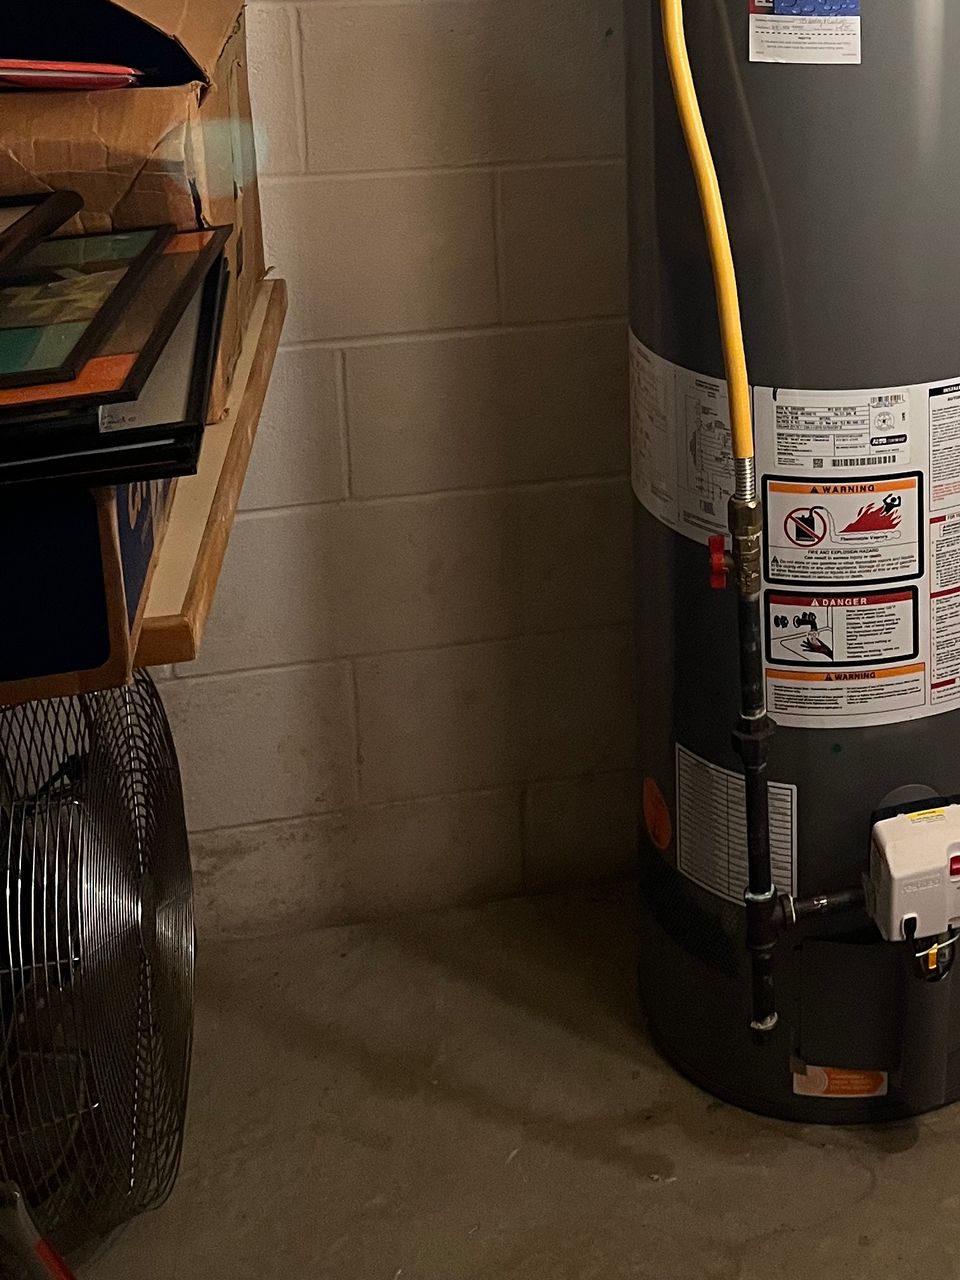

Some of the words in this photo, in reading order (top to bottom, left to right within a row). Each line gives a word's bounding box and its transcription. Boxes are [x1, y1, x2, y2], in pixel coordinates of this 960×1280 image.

[823, 484, 875, 494] WARNING
[822, 597, 867, 606] DANGER
[834, 672, 876, 681] WARNING
